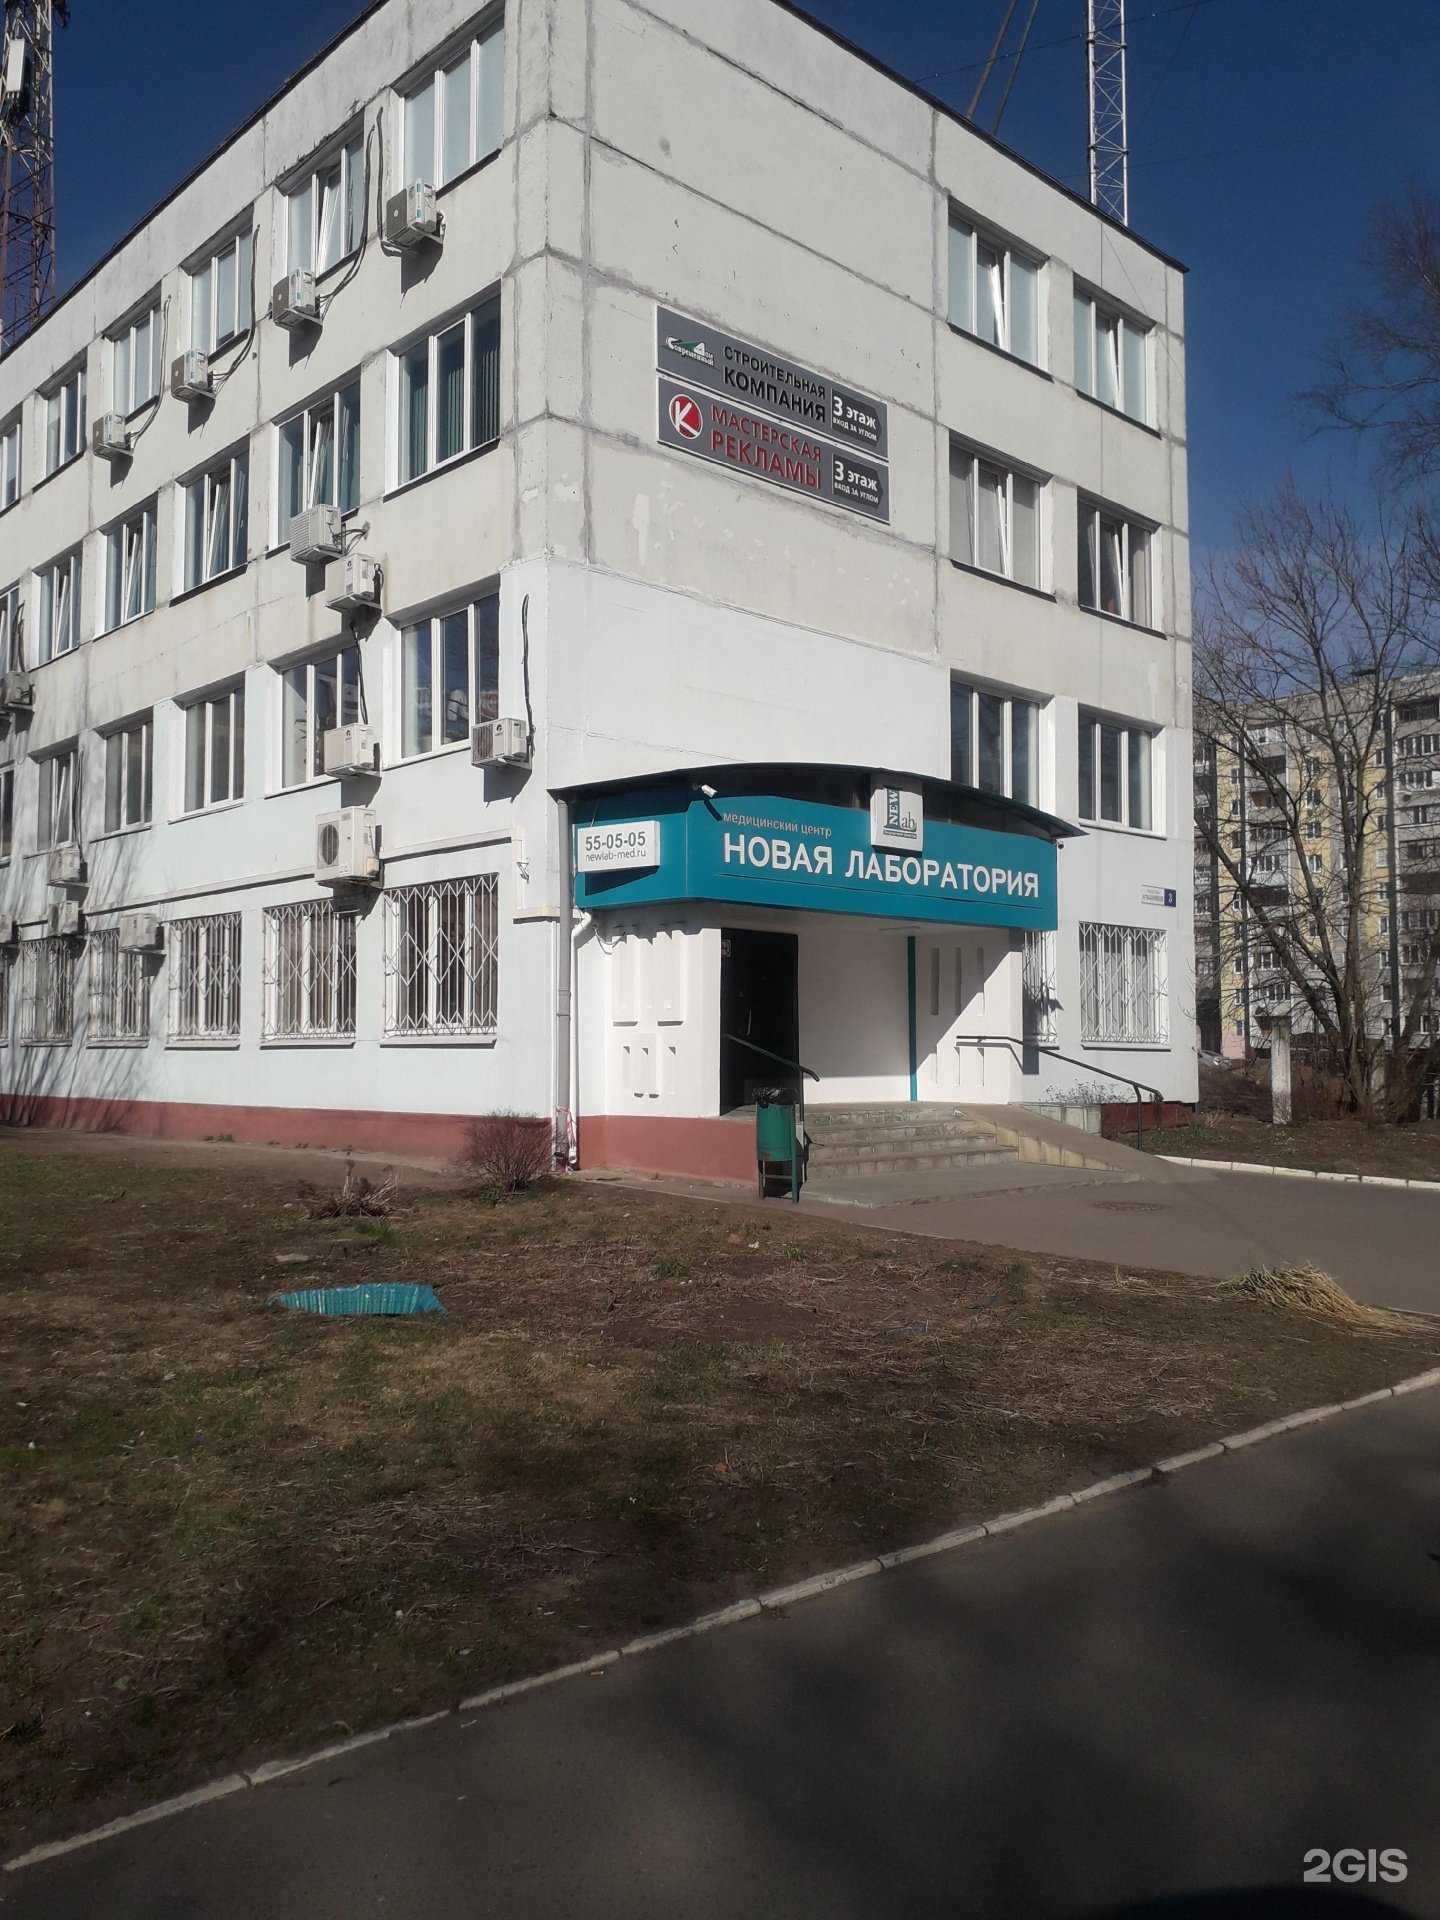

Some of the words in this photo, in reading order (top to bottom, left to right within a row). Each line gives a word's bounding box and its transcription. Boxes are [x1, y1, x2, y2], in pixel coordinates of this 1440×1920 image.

[723, 345, 826, 399] СТРОИТЕЛЬНАЯ
[723, 366, 826, 424] КОМПАНИЯ
[833, 396, 844, 417] 3
[846, 406, 877, 430] этаж
[711, 403, 822, 462] МАСТЕРСКАЯ
[711, 428, 821, 489] РЕКЛАМЫ
[834, 461, 845, 481] 3
[847, 471, 879, 492] этаж
[888, 789, 899, 826] NEW
[585, 831, 646, 851] 55-05-05
[801, 824, 832, 839] центр
[585, 848, 646, 862] newlab-med.ru
[723, 832, 833, 875] НОВАЯ
[844, 849, 1040, 899] ЛАБОРАТОРИЯ
